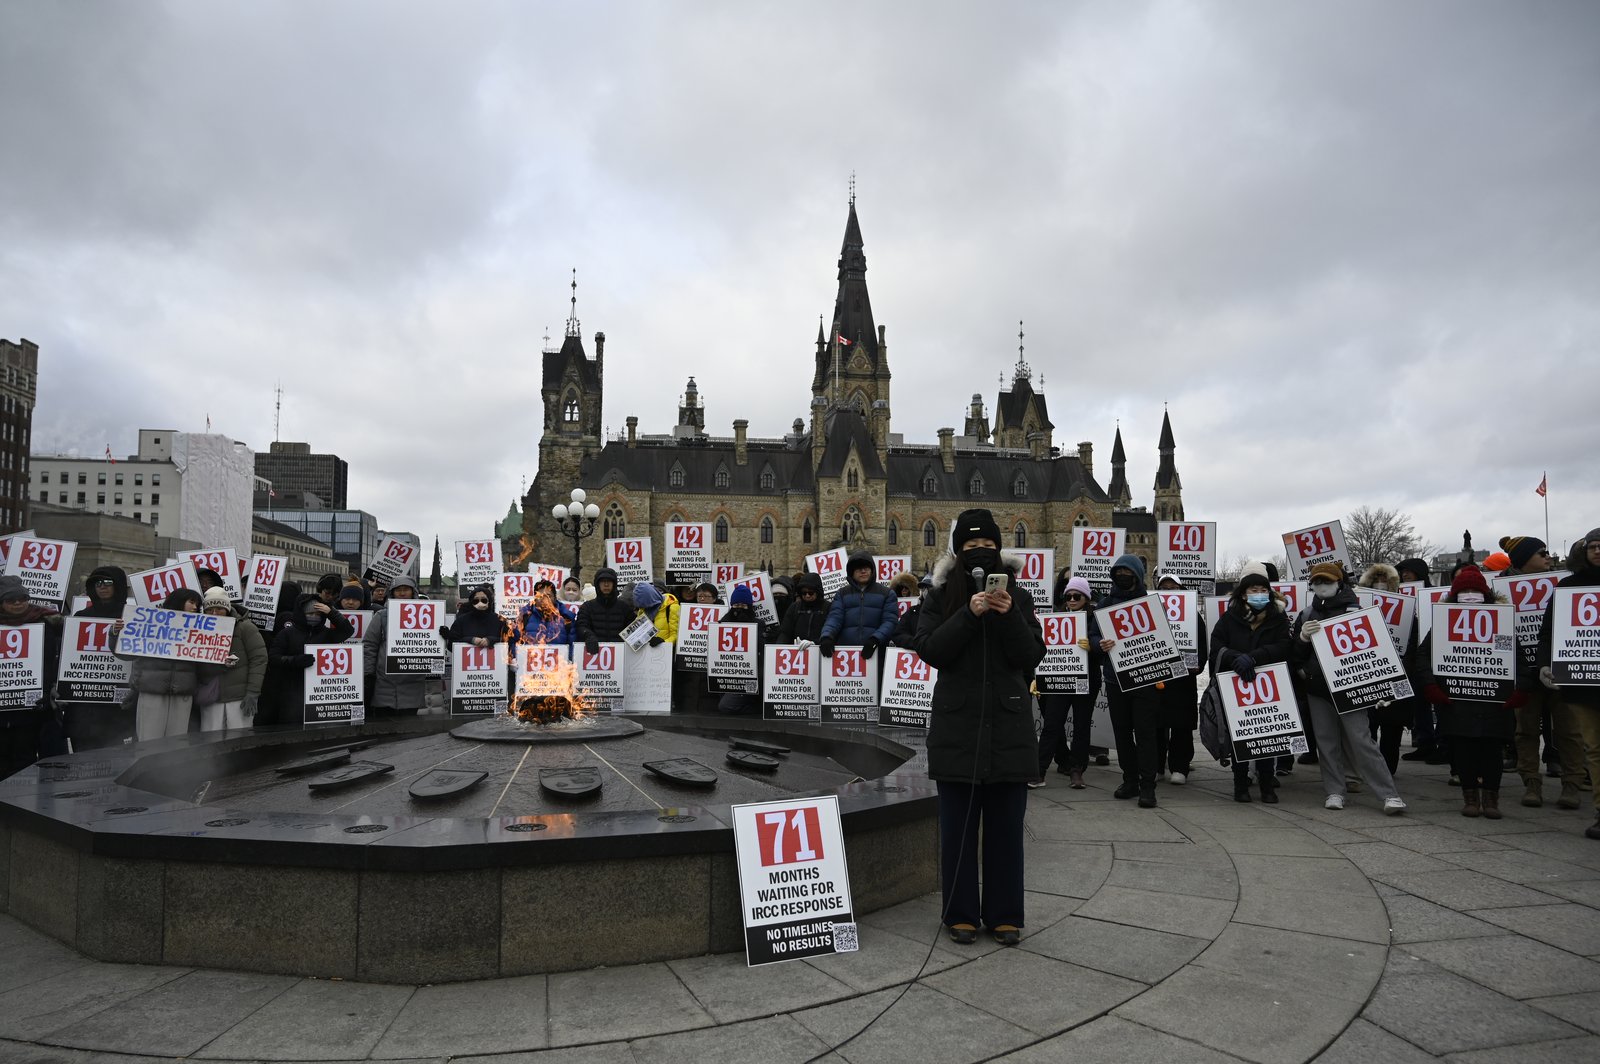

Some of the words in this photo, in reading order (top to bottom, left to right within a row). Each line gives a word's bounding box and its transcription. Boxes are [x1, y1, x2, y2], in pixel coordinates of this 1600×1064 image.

[678, 527, 699, 547] 42
[1086, 532, 1111, 555] 29
[1173, 526, 1201, 550] 40
[1301, 529, 1331, 555] 31
[24, 543, 57, 569] 39
[389, 544, 408, 561] 62
[468, 544, 490, 562] 34
[618, 542, 639, 562] 42
[1306, 555, 1334, 566] MONTHS
[257, 560, 276, 584] 39
[819, 553, 836, 573] 27
[21, 571, 52, 580] MONTHS
[151, 570, 182, 599] 40
[720, 567, 734, 583] 31
[507, 577, 530, 596] 30
[1516, 579, 1553, 610] 22
[134, 607, 176, 625] STOP
[182, 614, 217, 630] THE
[404, 604, 431, 628] 36
[692, 608, 714, 630] 34
[1115, 605, 1150, 637] 30
[1453, 610, 1492, 642] 40
[722, 628, 744, 651] 51
[1048, 618, 1073, 644] 30
[1332, 618, 1370, 654] 65
[1119, 645, 1150, 659] WAITING
[1151, 641, 1166, 650] FOR
[1124, 635, 1155, 648] MONTHS
[1453, 646, 1492, 655] MONTHS
[321, 649, 348, 675] 39
[467, 648, 490, 670] 11
[530, 649, 556, 671] 35
[779, 650, 805, 674] 34
[837, 651, 862, 676] 31
[899, 654, 927, 679] 34
[1118, 659, 1134, 668] IRCC
[1135, 648, 1174, 663] RESPONSE
[1335, 663, 1370, 677] WAITING
[1372, 658, 1390, 668] FOR
[1340, 651, 1376, 666] MONTHS
[1443, 655, 1481, 664] WAITING
[1144, 669, 1170, 680] RESULTS
[1333, 677, 1352, 688] IRCC
[1354, 666, 1398, 682] RESPONSE
[1459, 666, 1508, 676] RESPONSE
[1238, 673, 1274, 705] 90
[1458, 680, 1499, 688] TIMELINES
[1462, 688, 1495, 696] RESULTS
[1238, 716, 1271, 727] WAITING
[1274, 713, 1290, 722] FOR
[1244, 706, 1278, 717] MONTHS
[1236, 727, 1254, 737] IRCC
[1254, 721, 1297, 734] RESPONSE
[765, 810, 816, 863] 71
[769, 867, 819, 884] MONTHS
[758, 885, 808, 902] WAITING
[812, 881, 834, 895] FOR
[752, 905, 779, 920] IRCC
[781, 896, 843, 916] RESPONSE
[767, 929, 780, 940] NO
[783, 921, 833, 938] TIMELINES
[773, 942, 786, 953] NO
[790, 935, 831, 951] RESULTS
